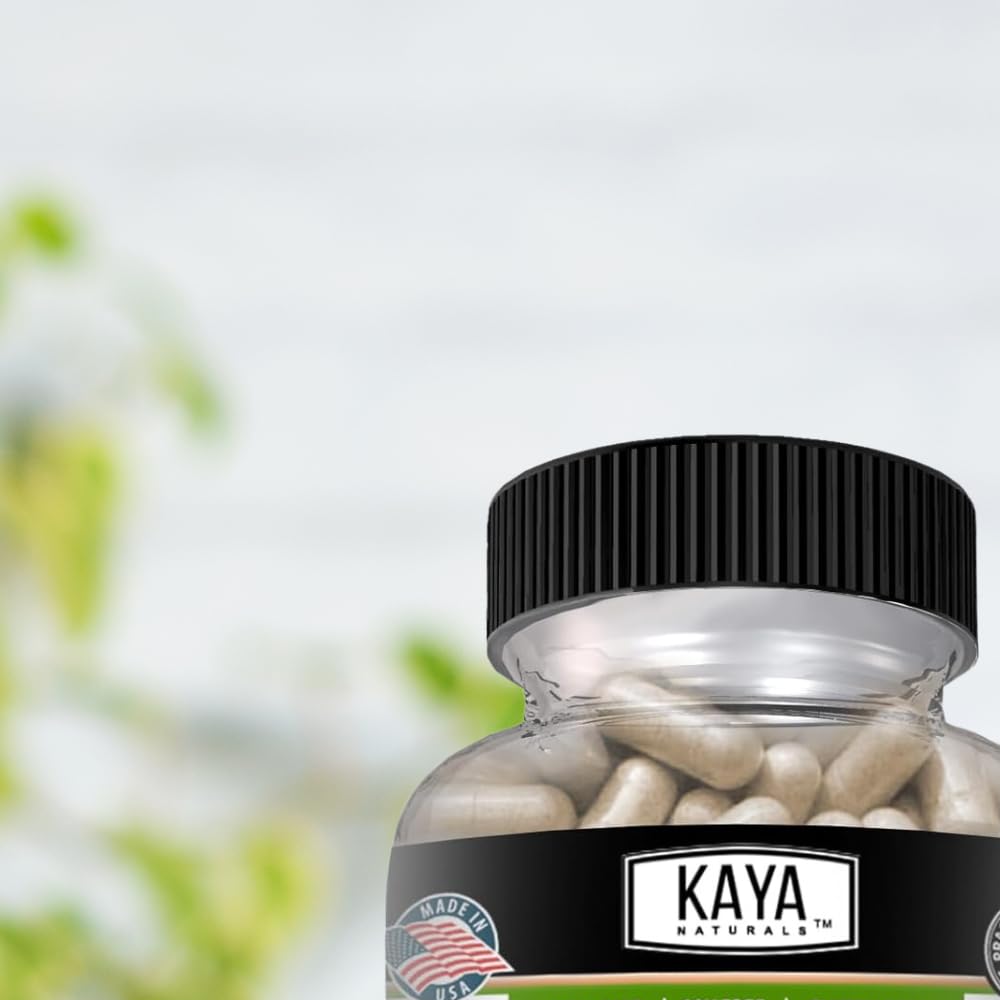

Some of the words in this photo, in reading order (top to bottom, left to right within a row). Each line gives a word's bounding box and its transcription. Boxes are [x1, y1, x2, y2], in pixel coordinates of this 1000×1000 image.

[678, 863, 807, 921] KAYA
[419, 898, 469, 919] MADE
[468, 911, 488, 933] IN
[676, 925, 807, 936] NATURALS
